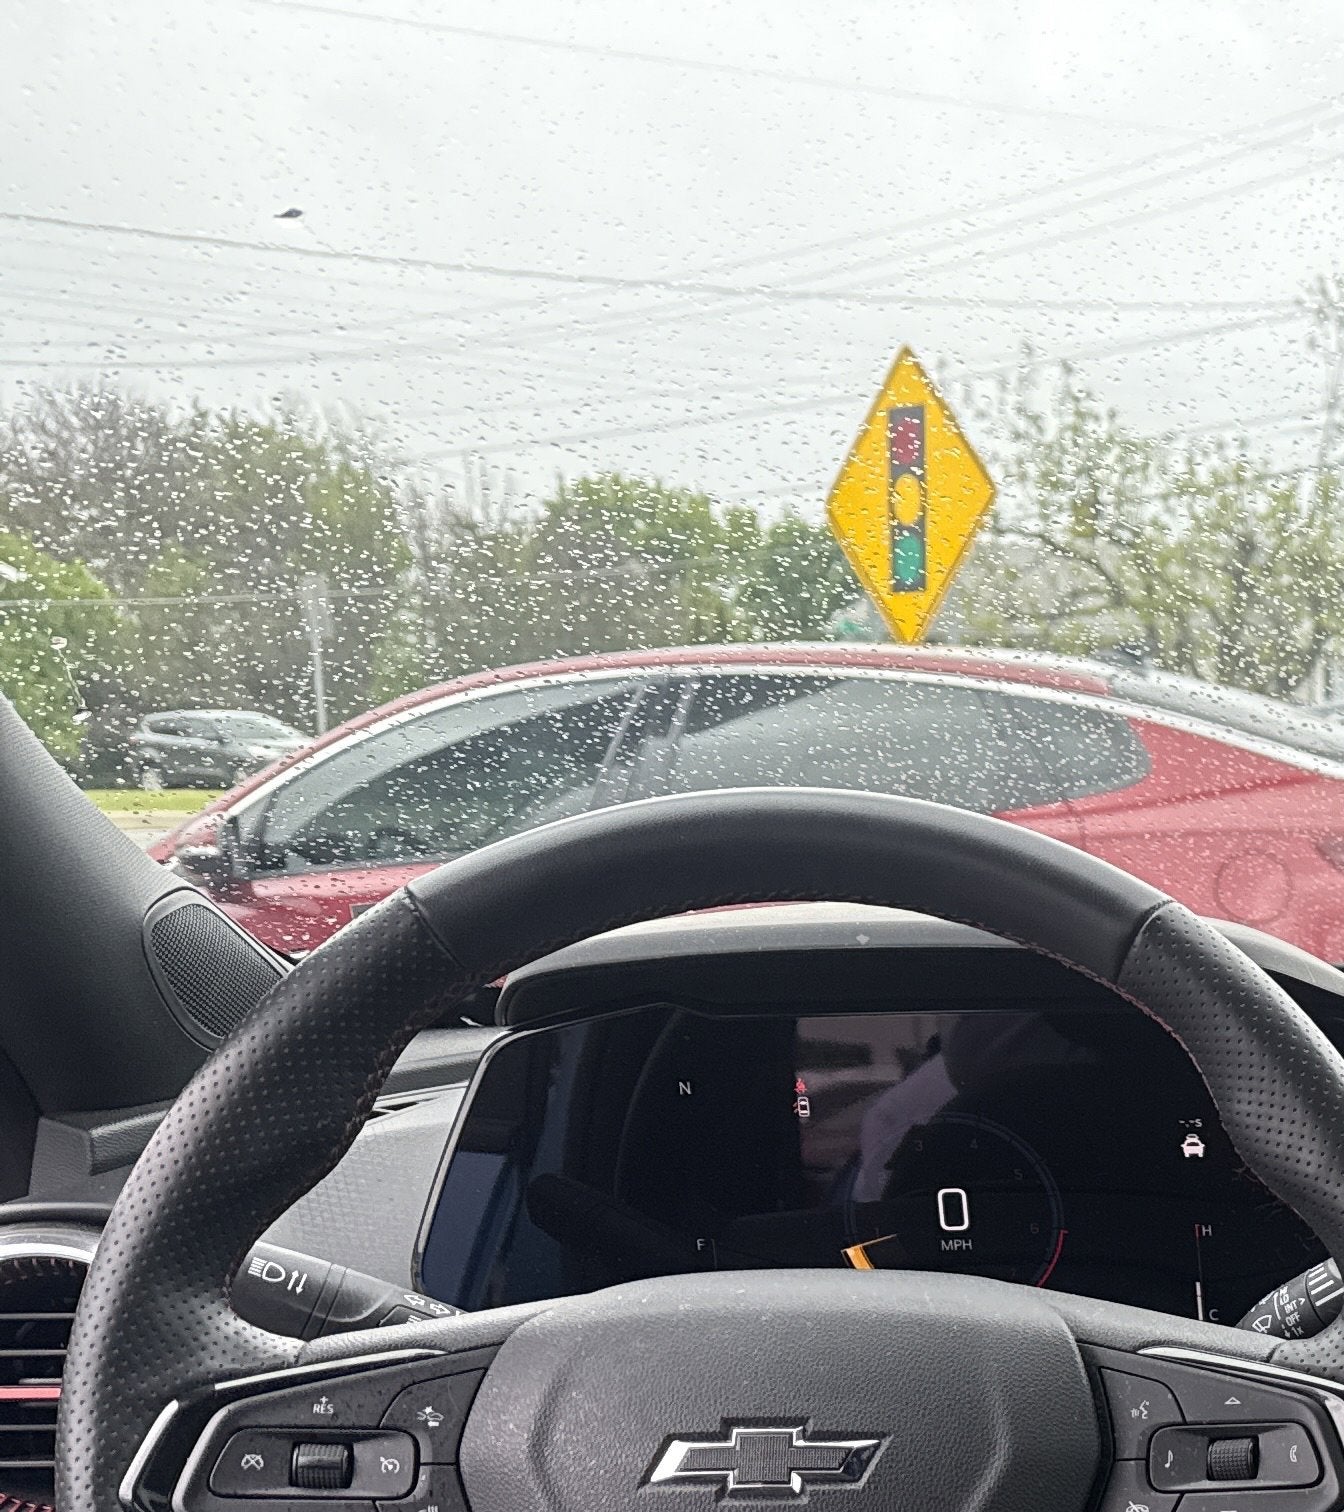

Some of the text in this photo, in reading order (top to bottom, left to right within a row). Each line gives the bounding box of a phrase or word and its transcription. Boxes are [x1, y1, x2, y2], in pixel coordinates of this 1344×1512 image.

[678, 1081, 692, 1095] N
[937, 1188, 969, 1230] 0
[1202, 1225, 1213, 1237] H
[697, 1238, 706, 1251] F
[941, 1240, 973, 1251] MPH
[1208, 1309, 1219, 1321] C
[1285, 1312, 1300, 1327] OFF
[313, 1403, 334, 1414] RES
